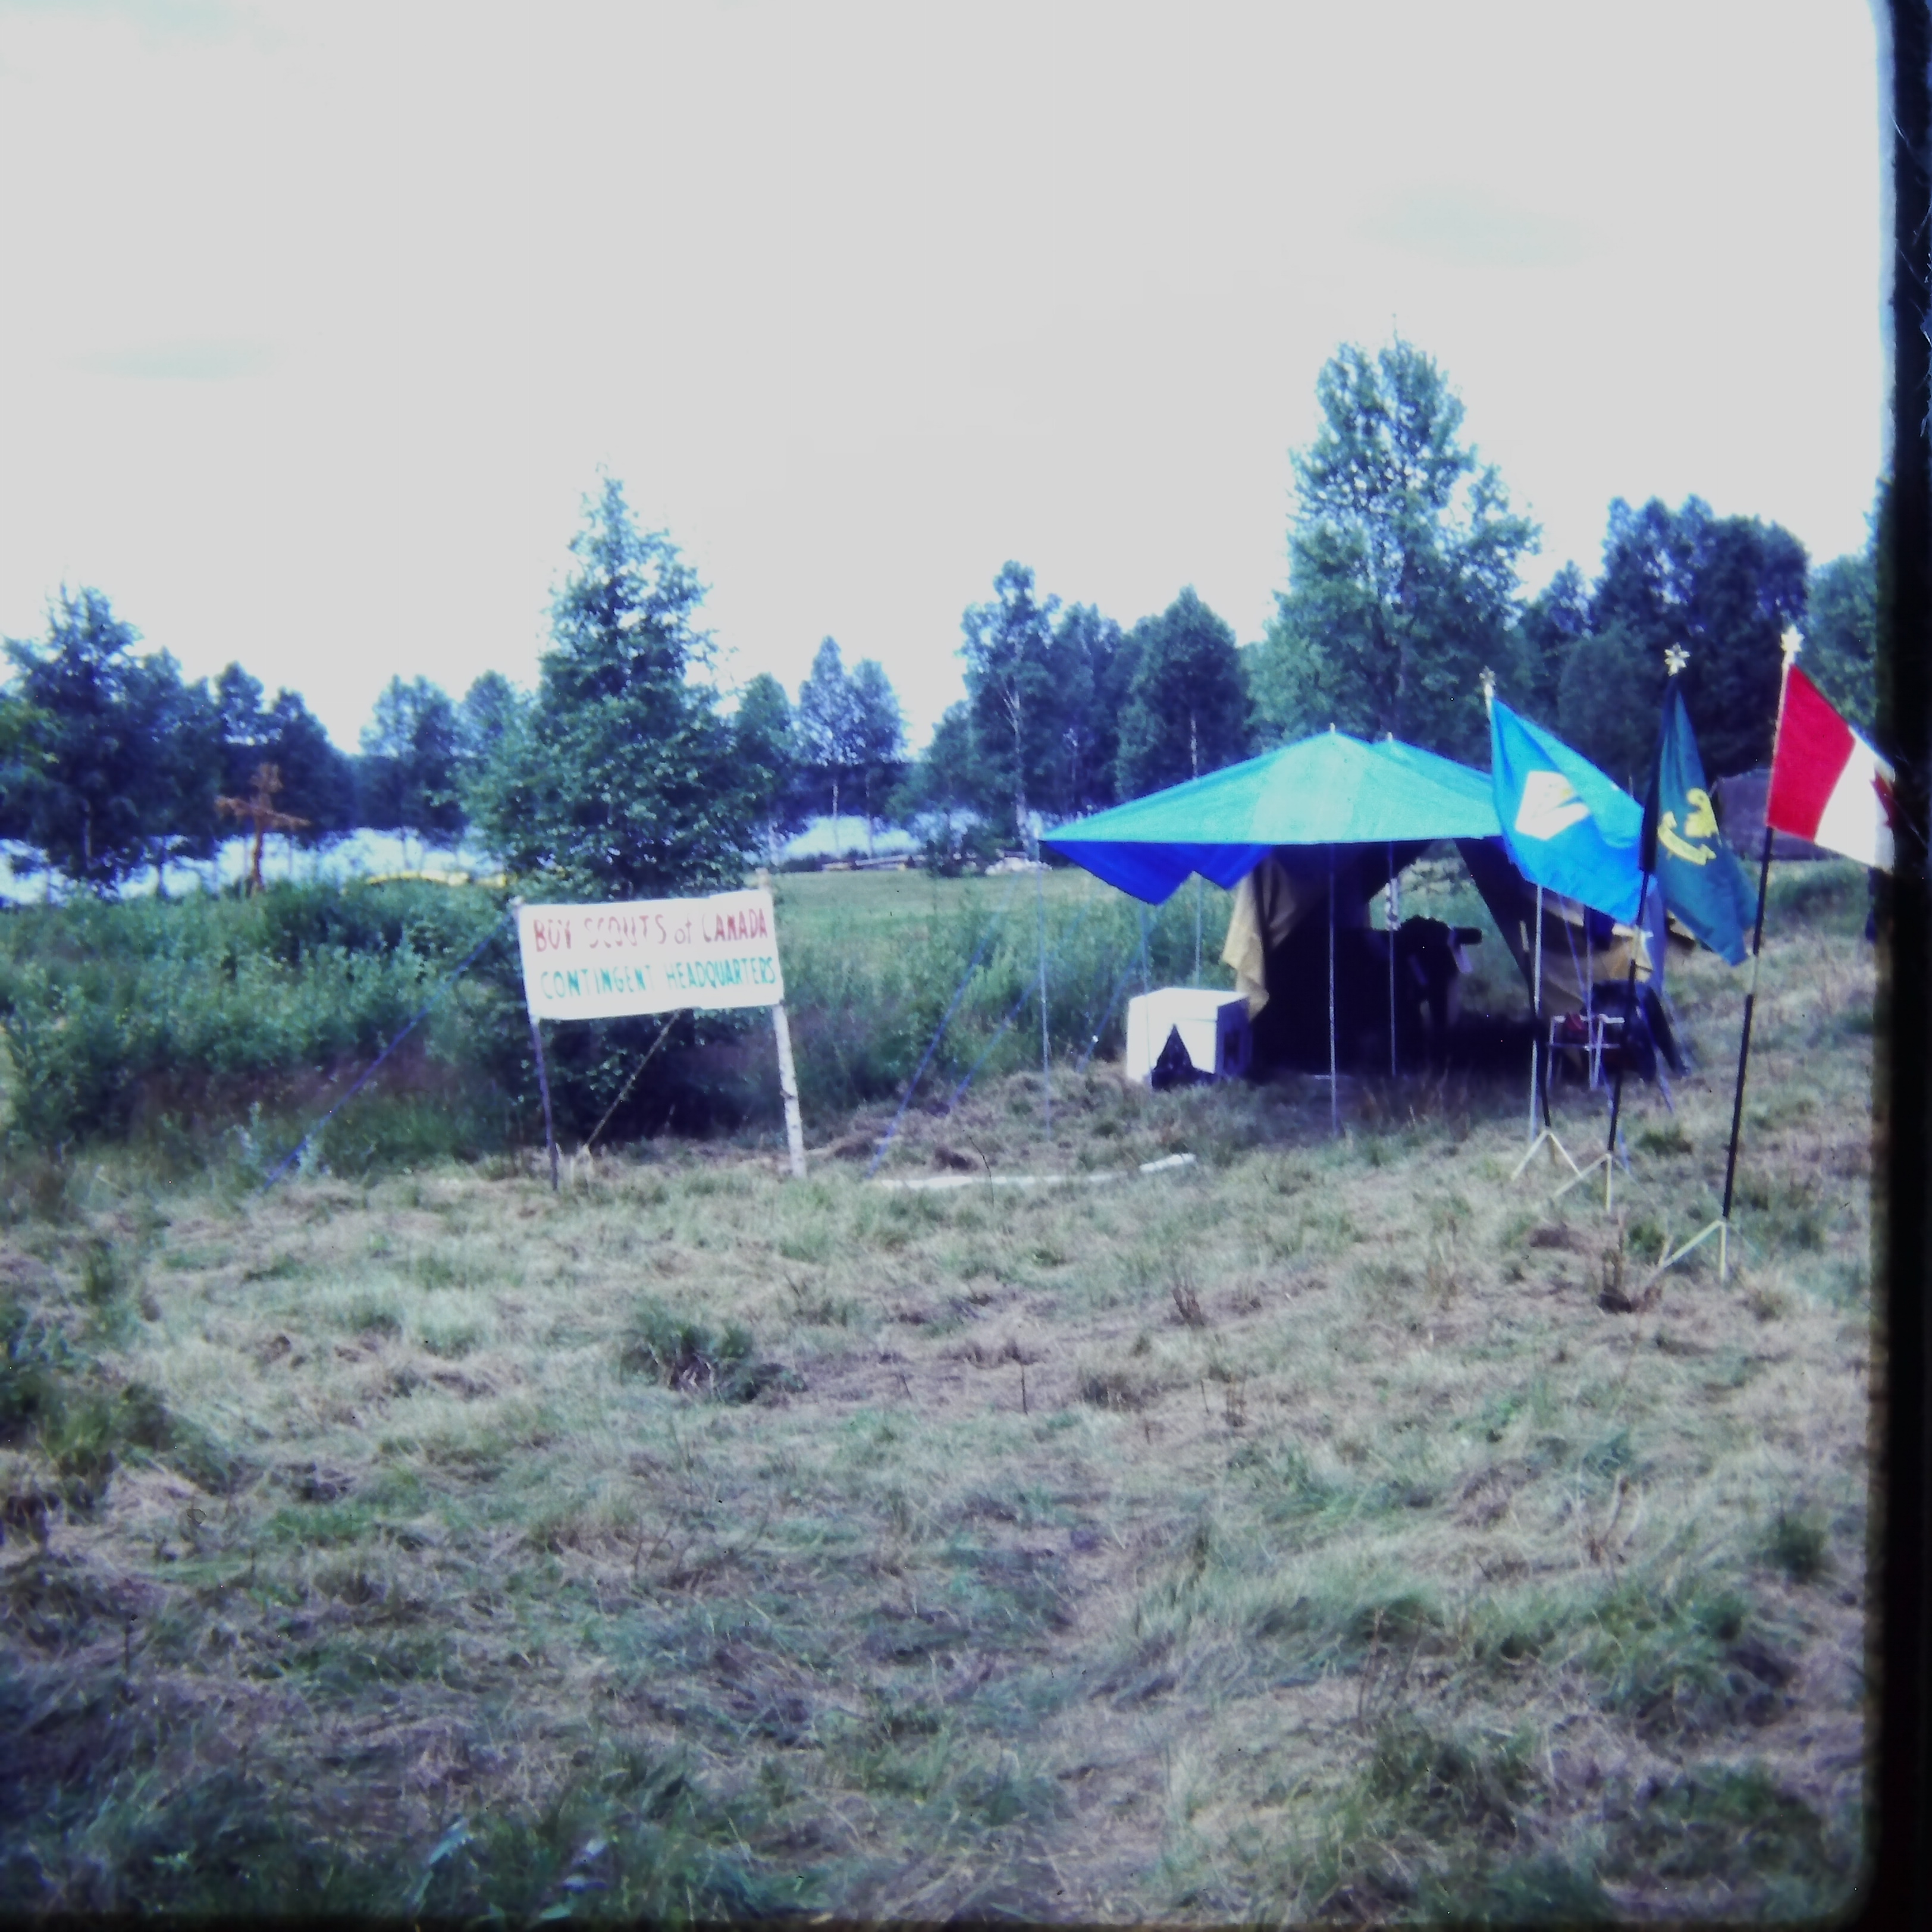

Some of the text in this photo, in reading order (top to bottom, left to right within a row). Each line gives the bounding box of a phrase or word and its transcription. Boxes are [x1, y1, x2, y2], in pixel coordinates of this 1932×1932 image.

[534, 908, 769, 952] BOY SCOUTS of CANADA
[540, 956, 776, 999] CONTINGENT HEADQUARTERS
